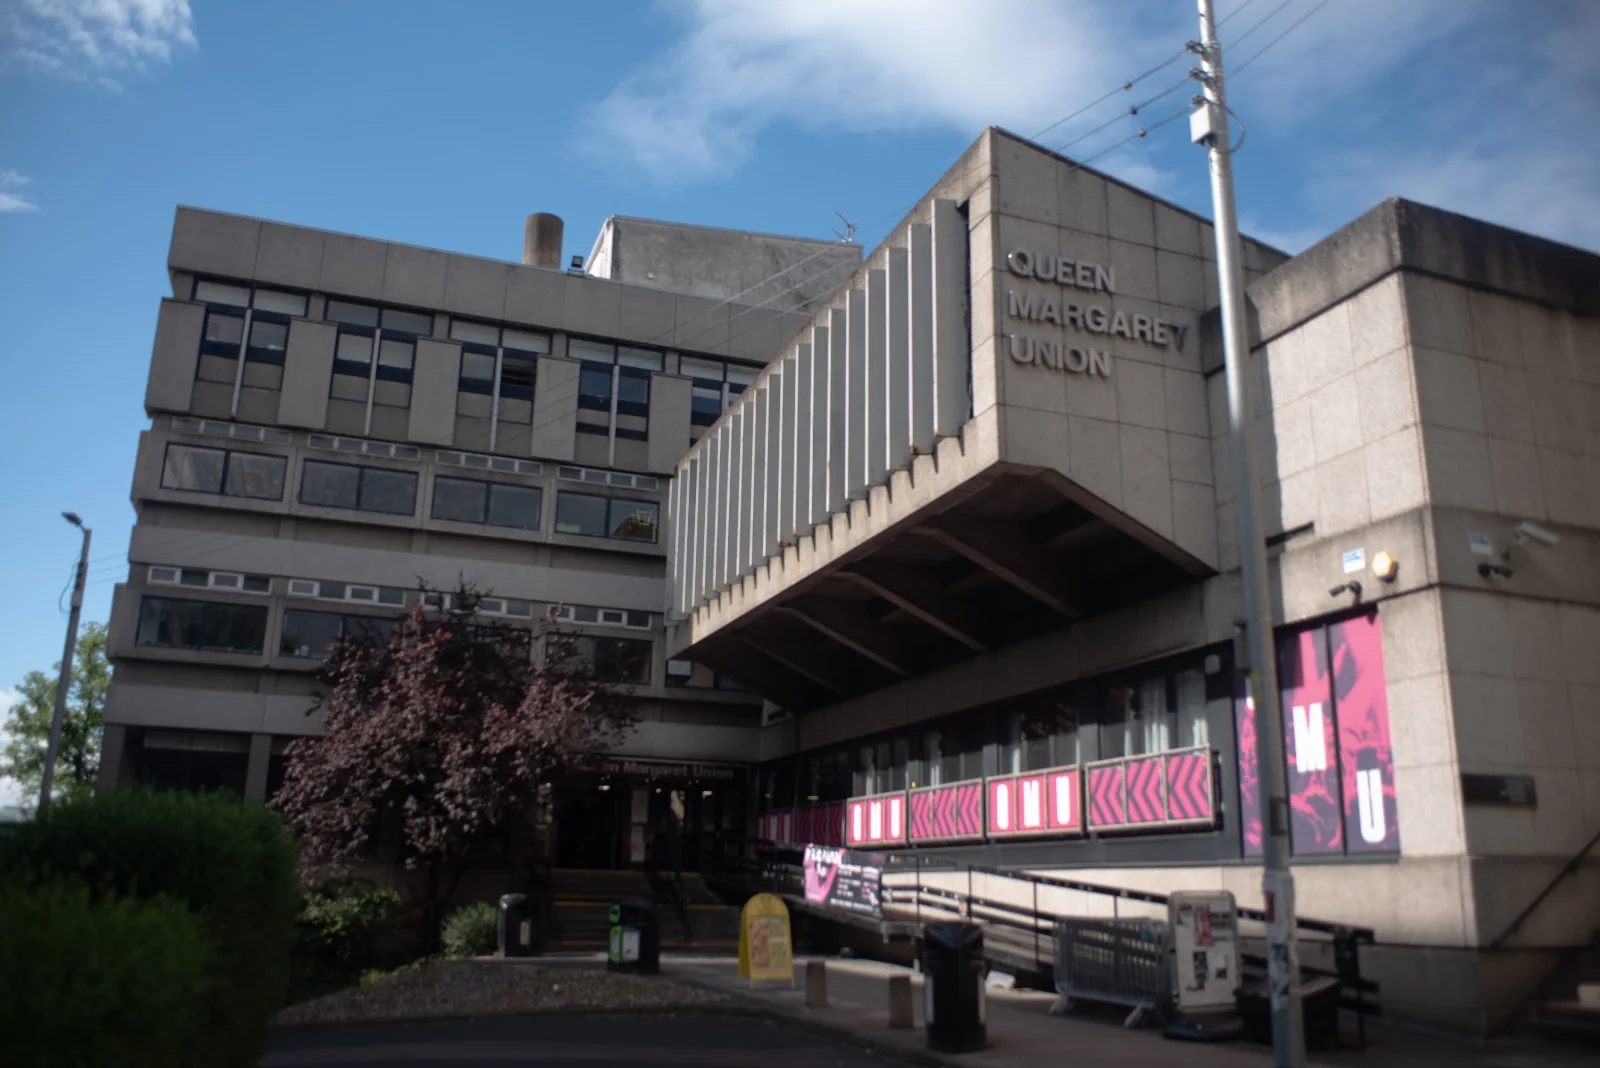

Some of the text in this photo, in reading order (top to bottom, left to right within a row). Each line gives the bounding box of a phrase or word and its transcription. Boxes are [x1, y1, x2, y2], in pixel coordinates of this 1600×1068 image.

[1008, 247, 1116, 291] QUEEN
[1008, 290, 1189, 350] MARGARET
[1010, 334, 1111, 377] UNION
[623, 760, 688, 777] Margaret
[692, 764, 735, 778] Union
